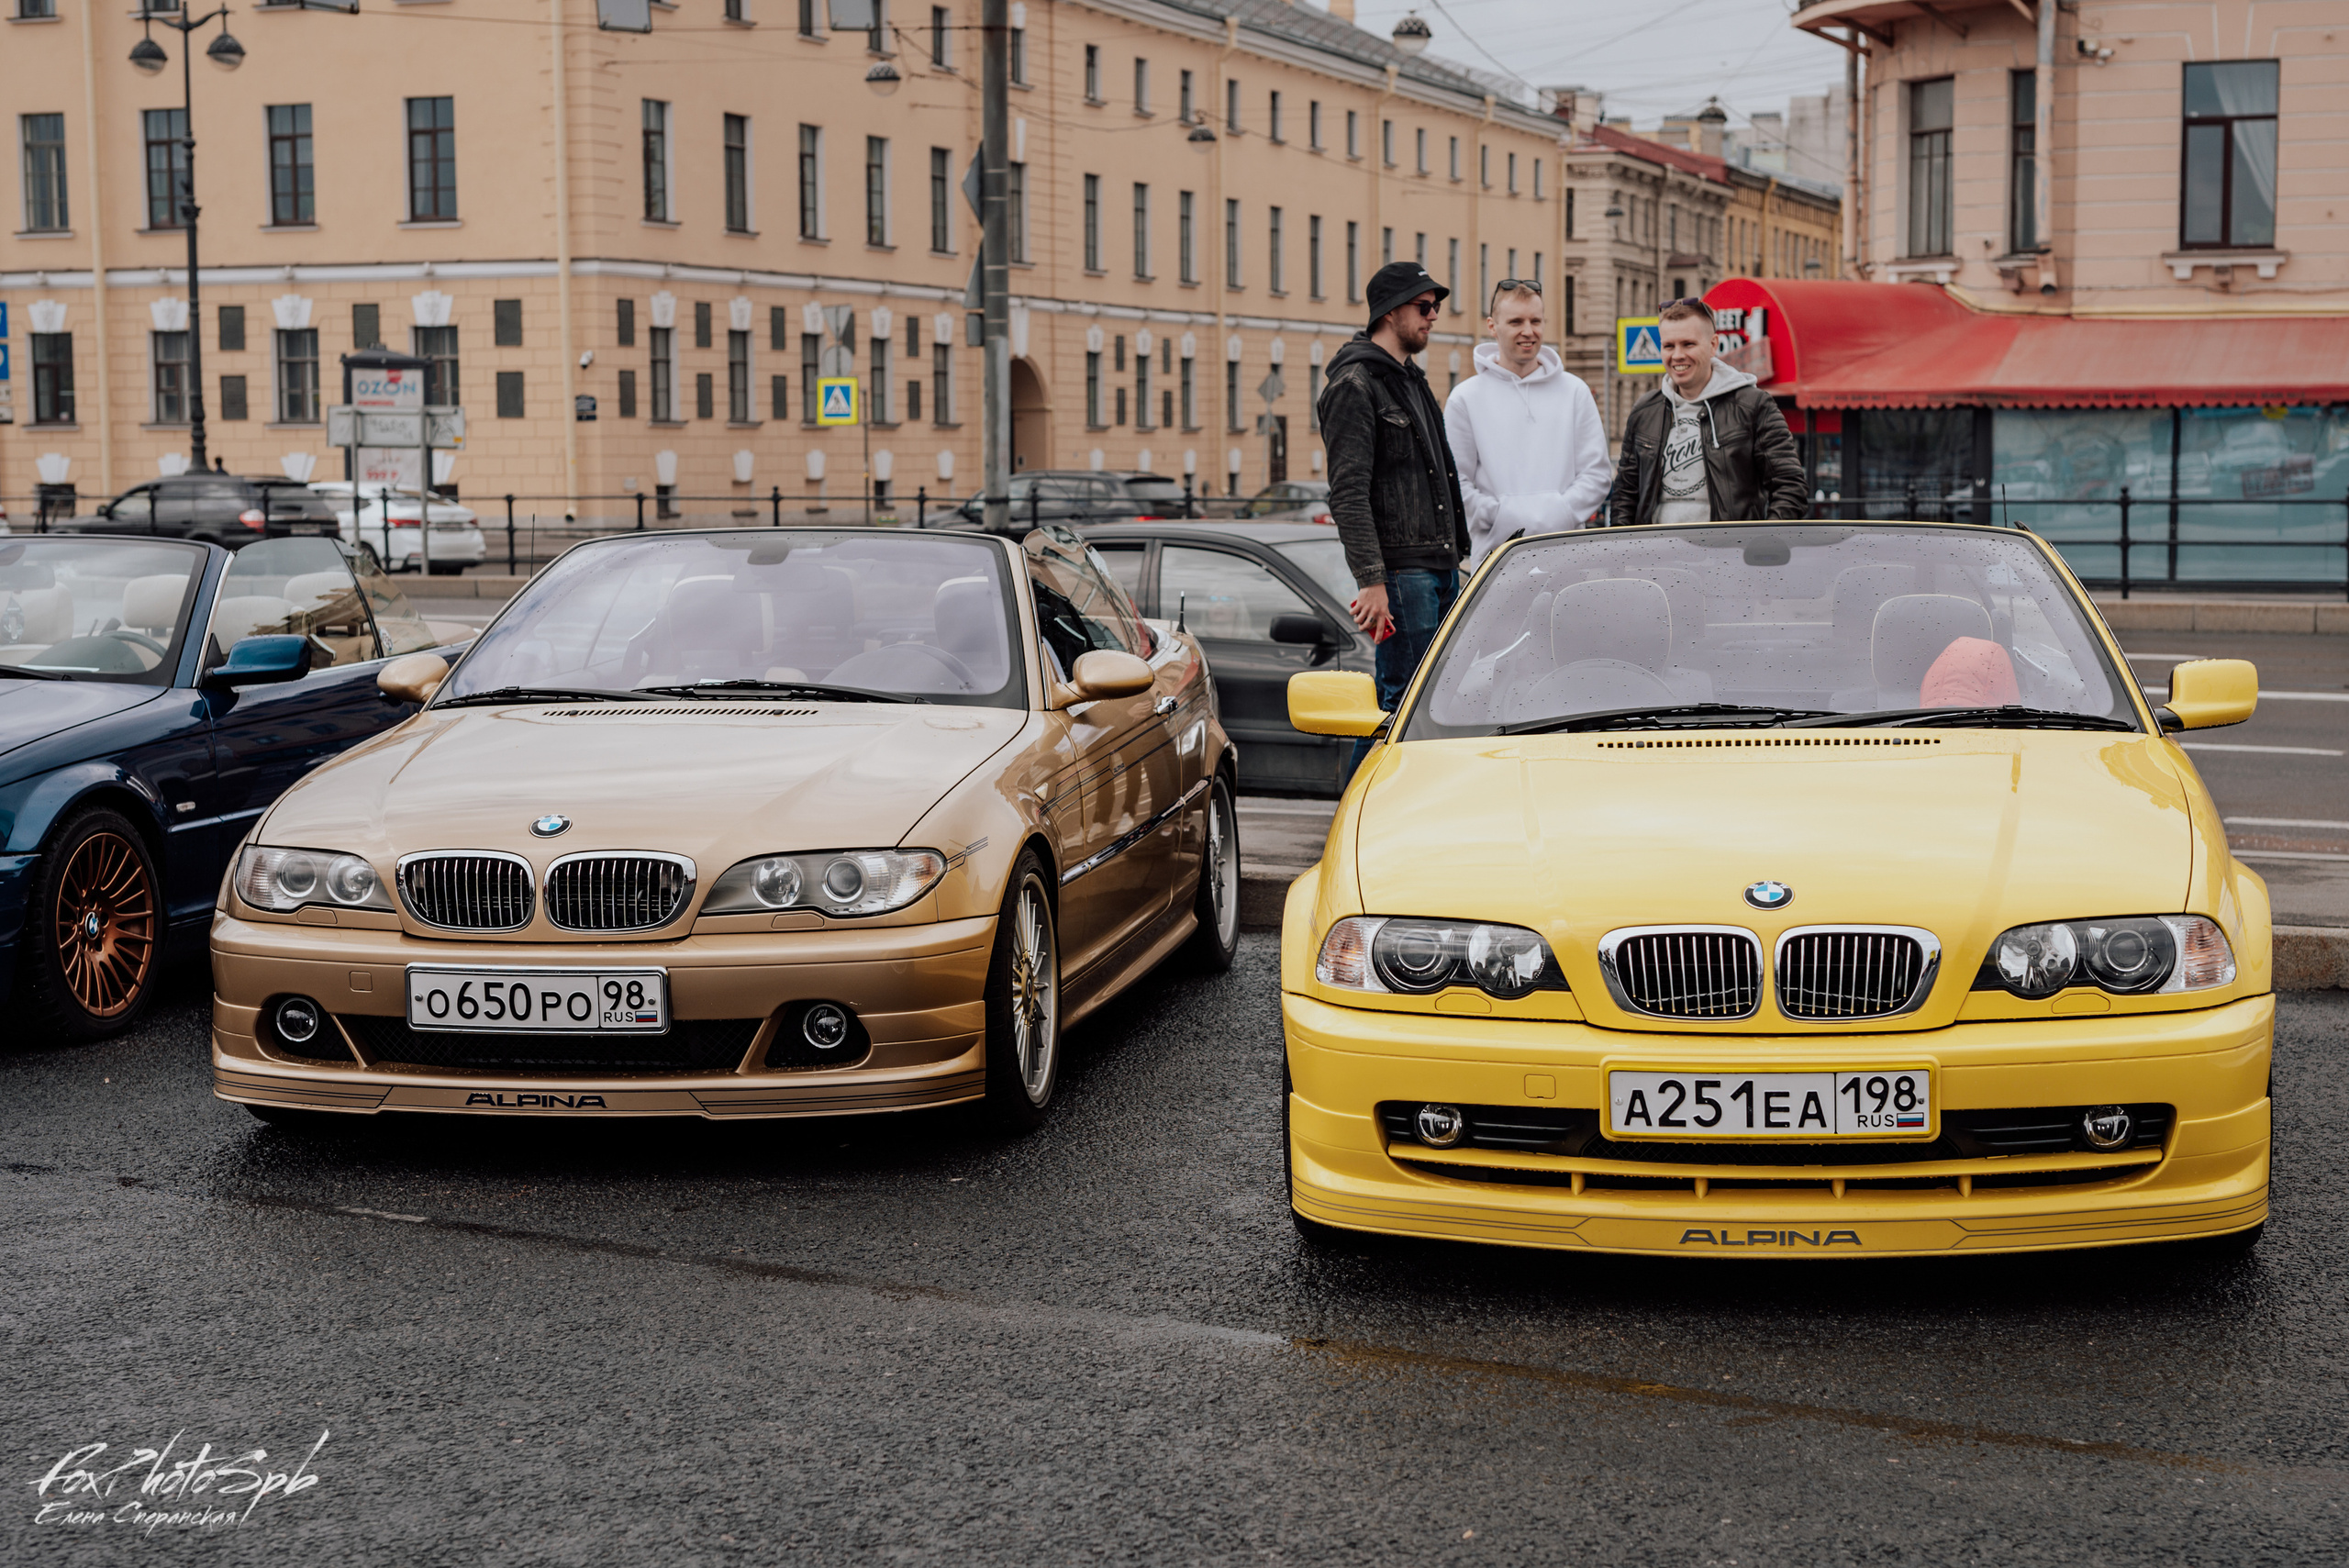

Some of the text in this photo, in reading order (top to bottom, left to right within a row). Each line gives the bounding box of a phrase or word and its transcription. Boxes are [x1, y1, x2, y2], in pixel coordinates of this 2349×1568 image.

[1713, 307, 1743, 330] EET
[358, 380, 417, 395] OZON
[603, 980, 645, 1010] 98
[604, 1011, 634, 1023] RUS
[465, 1092, 608, 1108] ALPINA
[1841, 1075, 1917, 1114] 198
[1857, 1114, 1895, 1128] RUS
[1679, 1229, 1863, 1246] ALPINA
